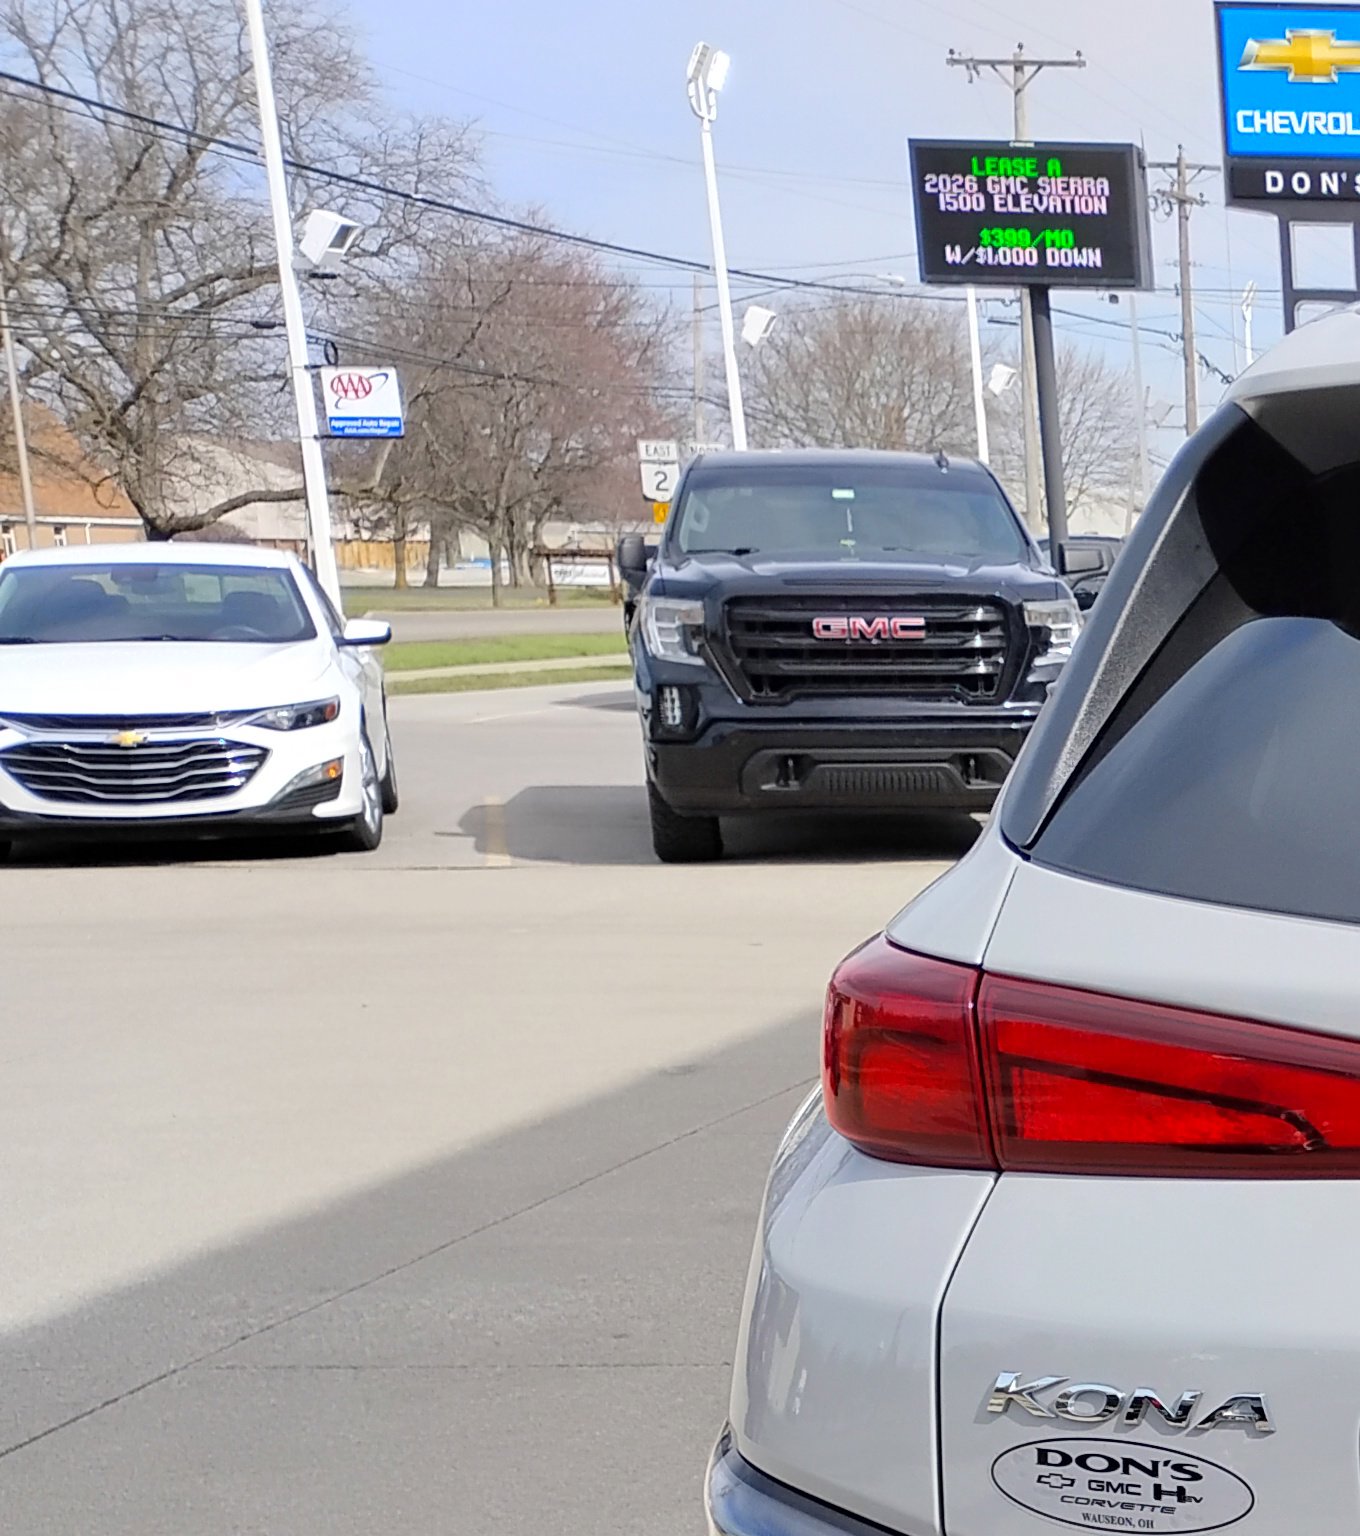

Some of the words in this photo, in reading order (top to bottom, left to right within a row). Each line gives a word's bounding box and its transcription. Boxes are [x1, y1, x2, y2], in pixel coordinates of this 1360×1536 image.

[972, 156, 1038, 177] LEASE
[1047, 158, 1061, 176] A
[924, 174, 978, 193] 2026
[987, 176, 1028, 194] GMC
[1038, 177, 1110, 196] SIERRA
[939, 193, 985, 211] 1500
[994, 195, 1107, 214] ELEVATION
[1046, 248, 1102, 267] DOWN
[333, 373, 371, 399] AAA
[645, 445, 672, 457] EAST
[654, 471, 669, 491] 2
[812, 616, 926, 640] GMC
[987, 1370, 1276, 1432] KONA
[1035, 1448, 1204, 1482] DON'S
[1088, 1479, 1142, 1497] GMC
[1060, 1495, 1176, 1514] CORVETTE
[1082, 1512, 1136, 1529] WAUSEON,
[1138, 1518, 1154, 1530] OH
